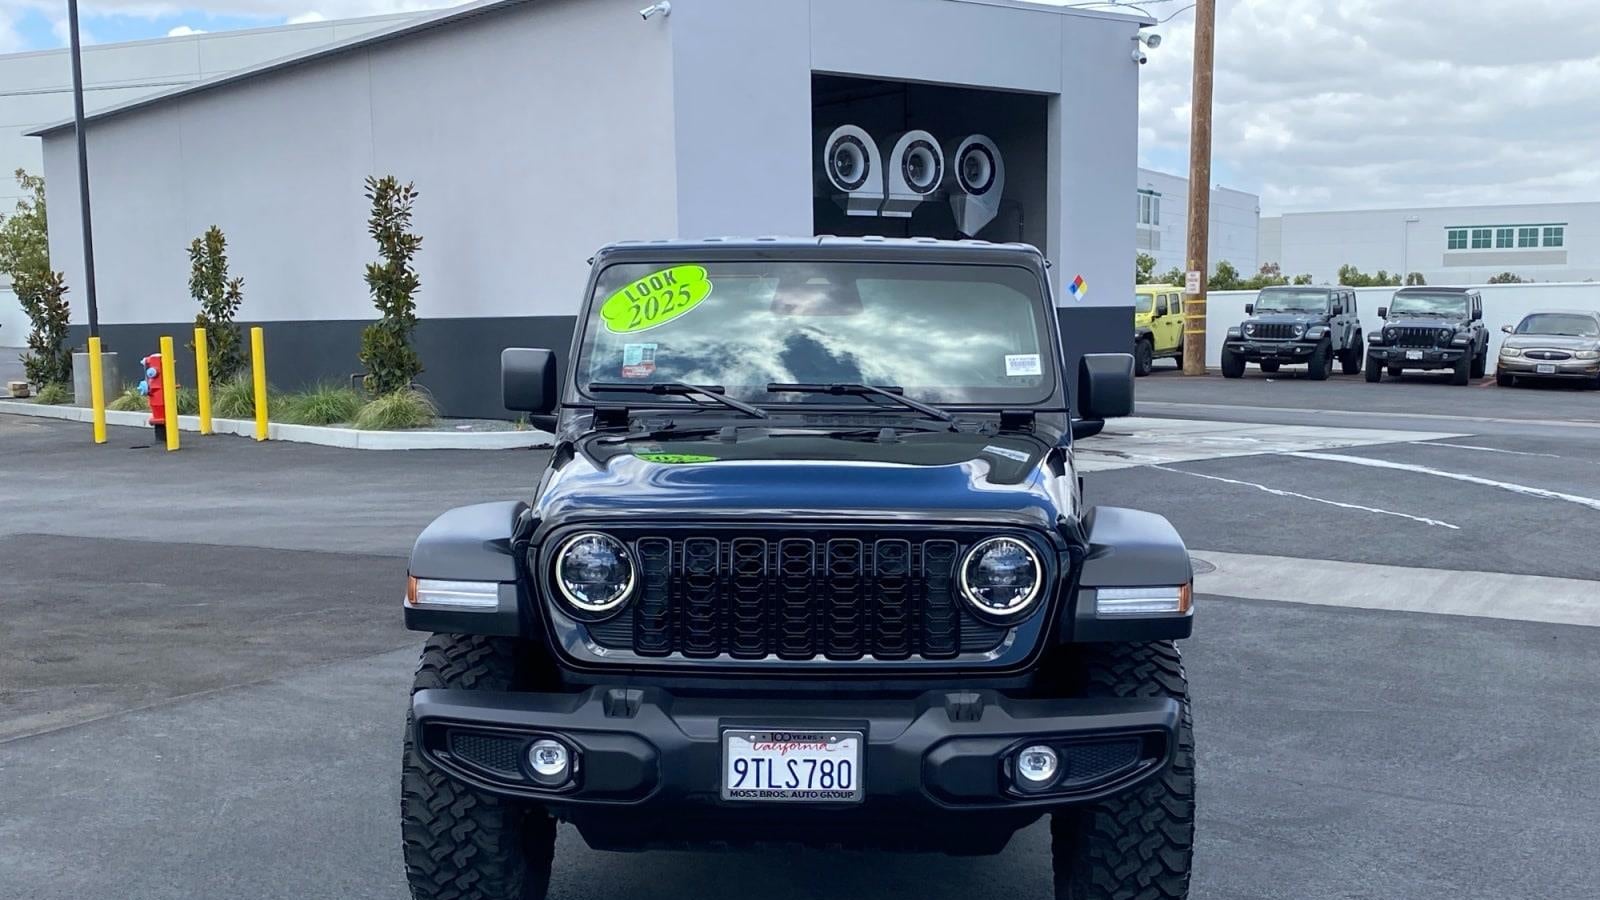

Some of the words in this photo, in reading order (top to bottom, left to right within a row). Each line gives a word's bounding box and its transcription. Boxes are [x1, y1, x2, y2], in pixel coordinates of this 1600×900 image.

[624, 270, 677, 303] LOOK
[628, 284, 691, 328] 2025
[753, 742, 835, 755] California
[733, 758, 851, 788] 9TLS780
[730, 790, 758, 798] MOSS
[760, 790, 788, 799] BROS.
[791, 791, 818, 799] AUTO
